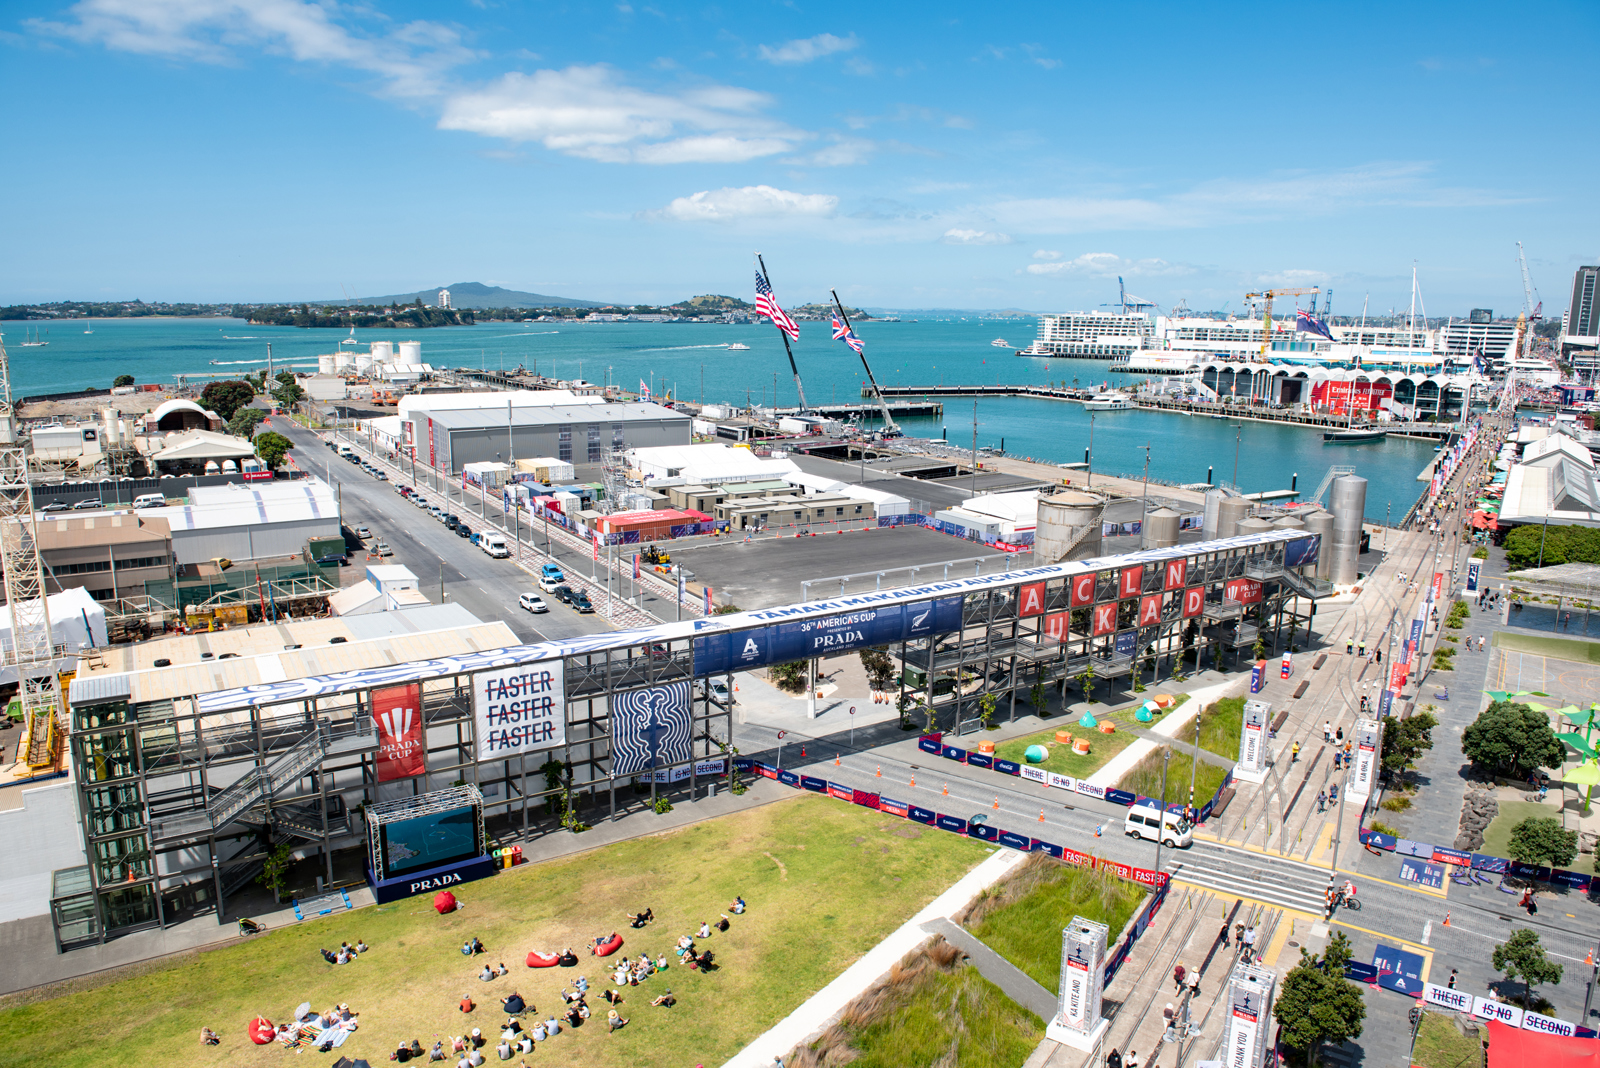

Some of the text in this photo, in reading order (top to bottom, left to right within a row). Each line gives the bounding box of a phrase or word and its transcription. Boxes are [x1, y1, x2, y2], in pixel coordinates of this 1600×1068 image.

[842, 582, 962, 606] MAKAURAU
[962, 566, 1063, 586] AUCKLAND
[1240, 582, 1261, 592] PRADA
[1244, 590, 1258, 599] CUP
[816, 616, 859, 630] AMERICA'S
[860, 612, 876, 622] CUP
[814, 630, 864, 648] PRADA
[486, 671, 552, 701] FASTER
[488, 696, 554, 726] FASTER
[488, 720, 554, 751] FASTER
[379, 740, 420, 753] PRADA
[388, 750, 412, 760] CUP
[1247, 737, 1256, 762] WELCOME
[675, 770, 682, 779] IS
[682, 768, 691, 777] NO
[698, 762, 723, 772] SECOND
[1024, 768, 1103, 795] THERE IS NO SECOND
[410, 873, 462, 893] PRADA
[1071, 993, 1080, 1009] KITE
[1070, 1008, 1078, 1017] KA
[1432, 988, 1571, 1037] THERE IS NO SECOND
[1234, 1031, 1247, 1068] THANK YOU
